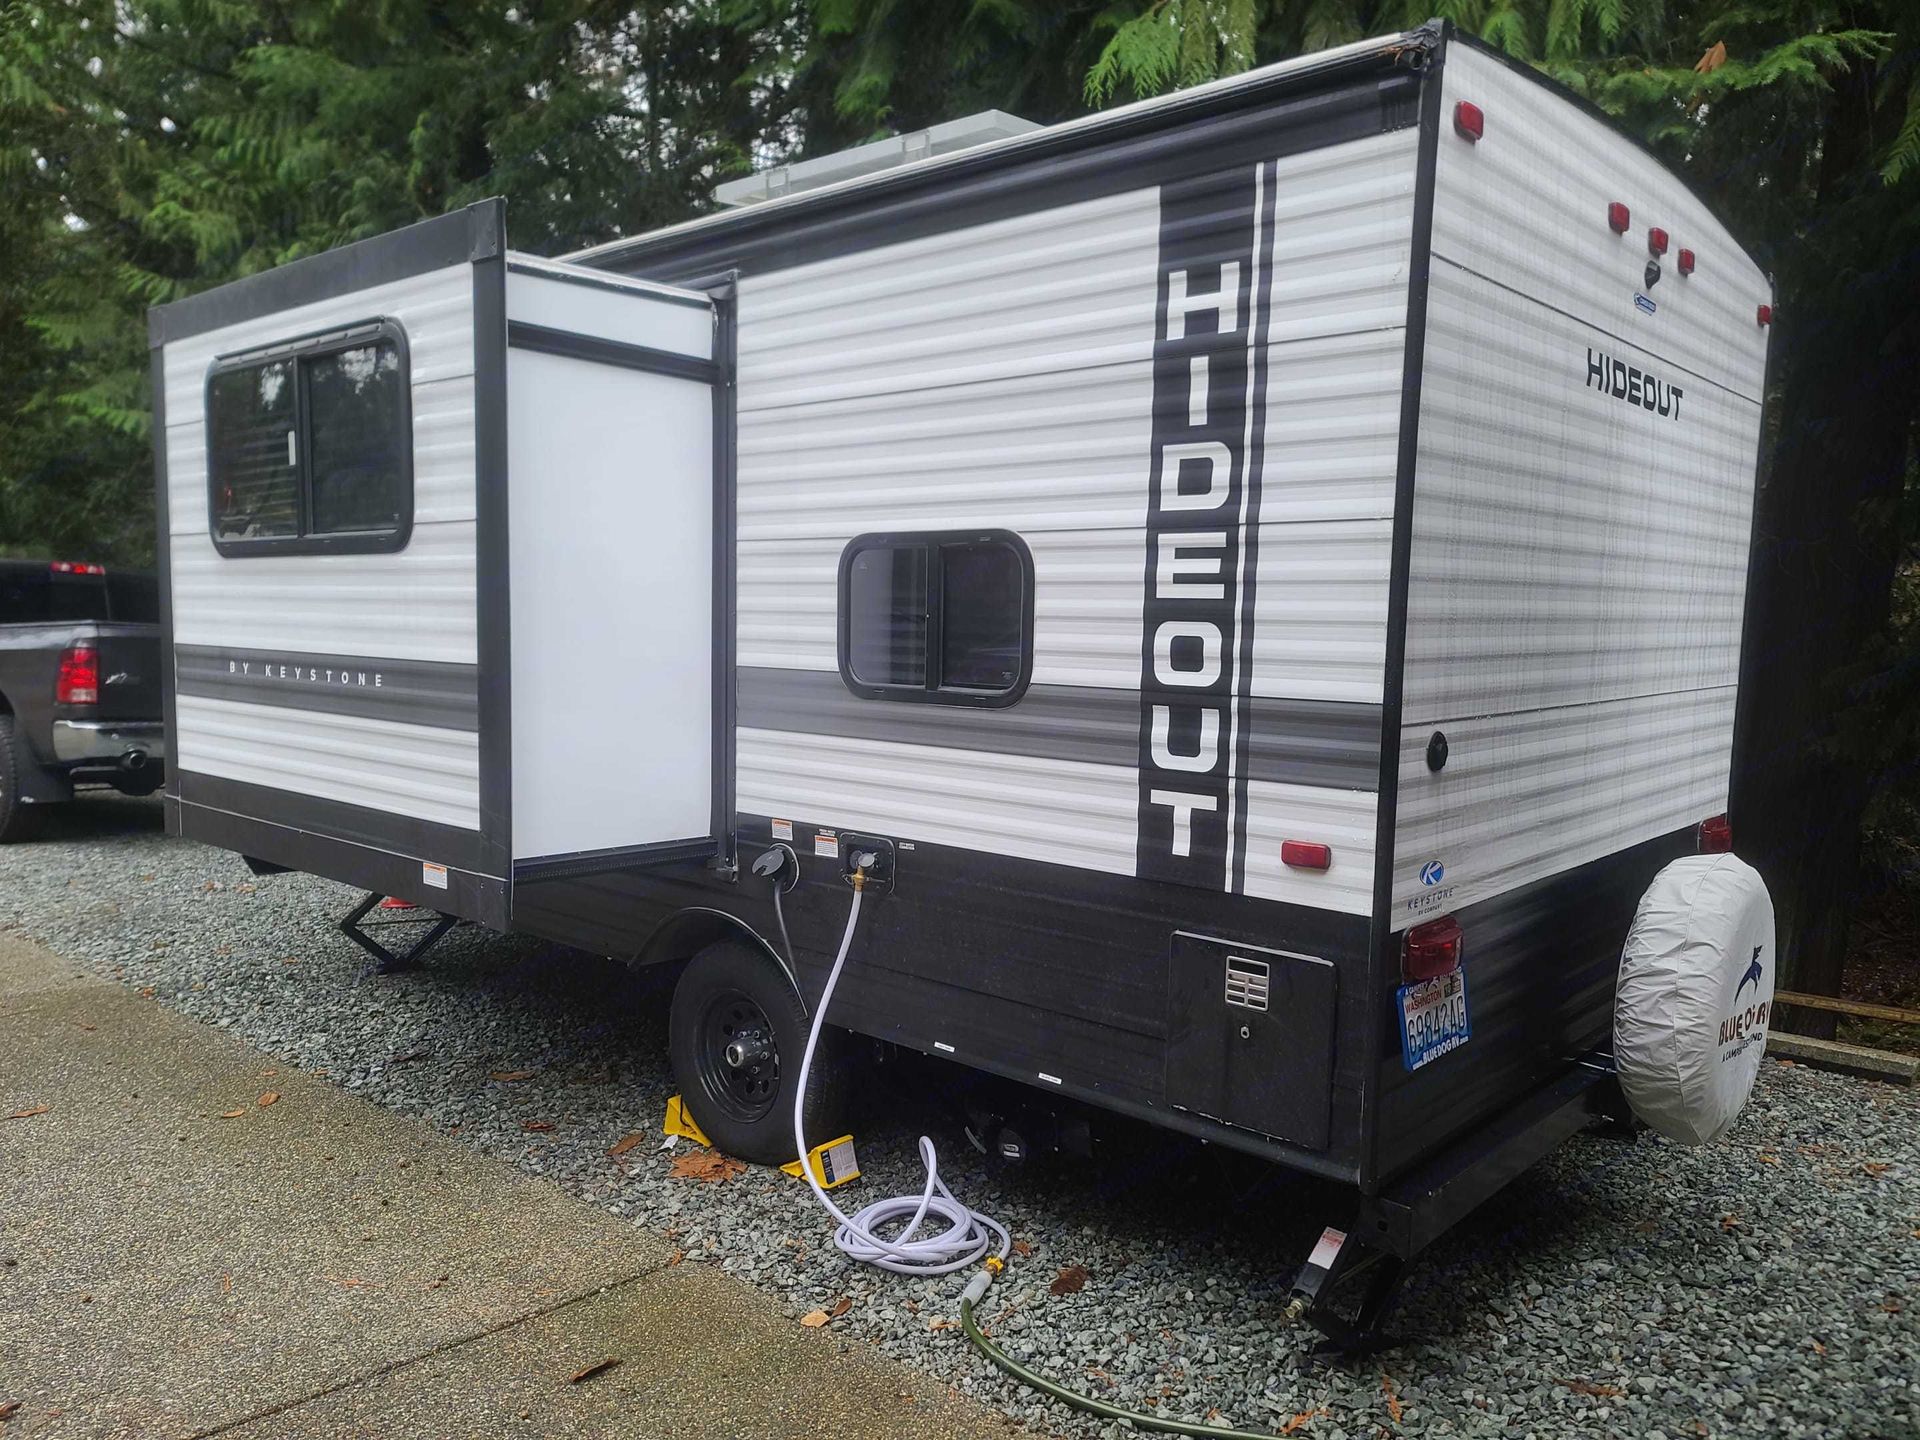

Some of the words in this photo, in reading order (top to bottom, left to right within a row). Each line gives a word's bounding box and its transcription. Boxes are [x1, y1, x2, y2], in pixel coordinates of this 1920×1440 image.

[1586, 347, 1684, 421] HIDEOUT
[1150, 261, 1240, 857] HIDEOUT
[229, 660, 249, 675] BY
[265, 664, 382, 687] KEYSTONE
[1407, 887, 1454, 911] KEYSTONE
[1404, 989, 1442, 1014] WASHINGTON
[1407, 995, 1466, 1055] 69842AG
